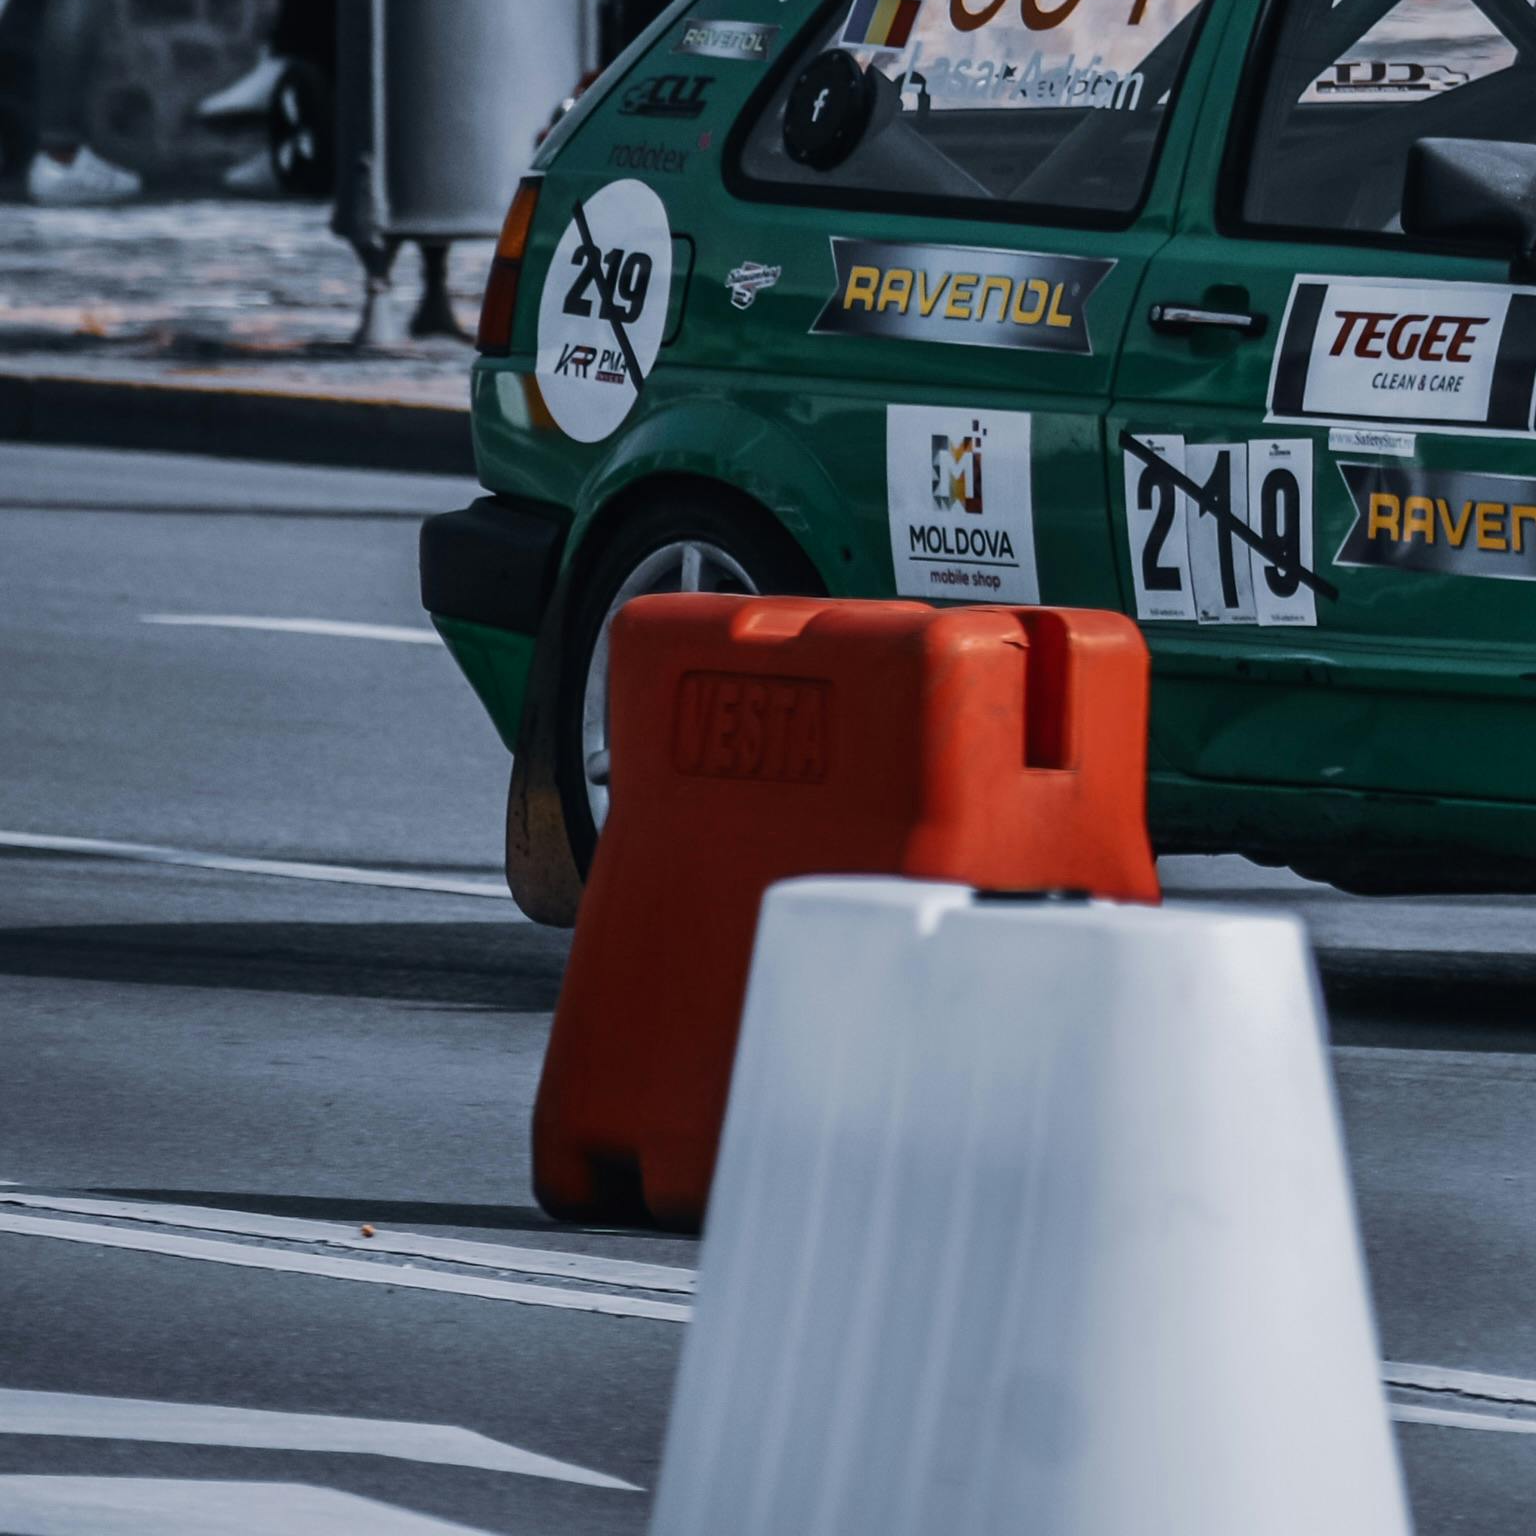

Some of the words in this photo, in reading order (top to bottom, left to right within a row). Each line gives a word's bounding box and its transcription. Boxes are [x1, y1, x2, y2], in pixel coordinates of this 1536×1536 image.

[682, 28, 764, 52] RAVENOL
[562, 245, 652, 324] 219
[842, 266, 1073, 328] RAVENOL
[1328, 310, 1491, 363] TEGEE
[1371, 371, 1415, 391] CLEAN
[1417, 373, 1427, 392] &
[1429, 373, 1464, 393] CARE
[909, 525, 1014, 559] MOLDOVA
[930, 568, 969, 586] mobile
[972, 571, 1001, 591] shop
